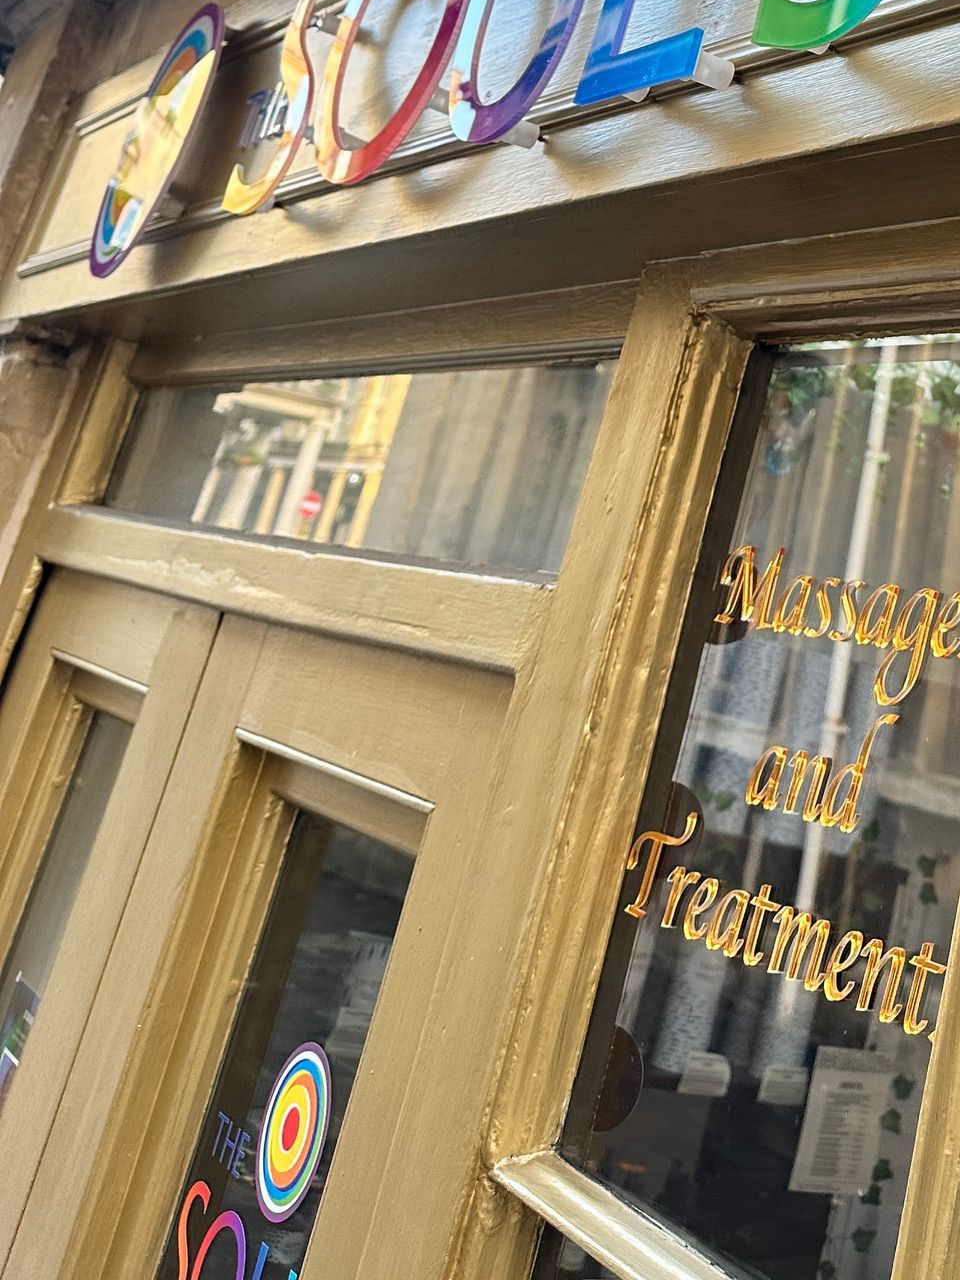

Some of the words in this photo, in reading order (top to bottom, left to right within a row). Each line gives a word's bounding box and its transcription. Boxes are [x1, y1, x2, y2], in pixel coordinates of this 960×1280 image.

[745, 713, 900, 834] and
[624, 811, 947, 1043] Treatment
[211, 1110, 251, 1179] THE
